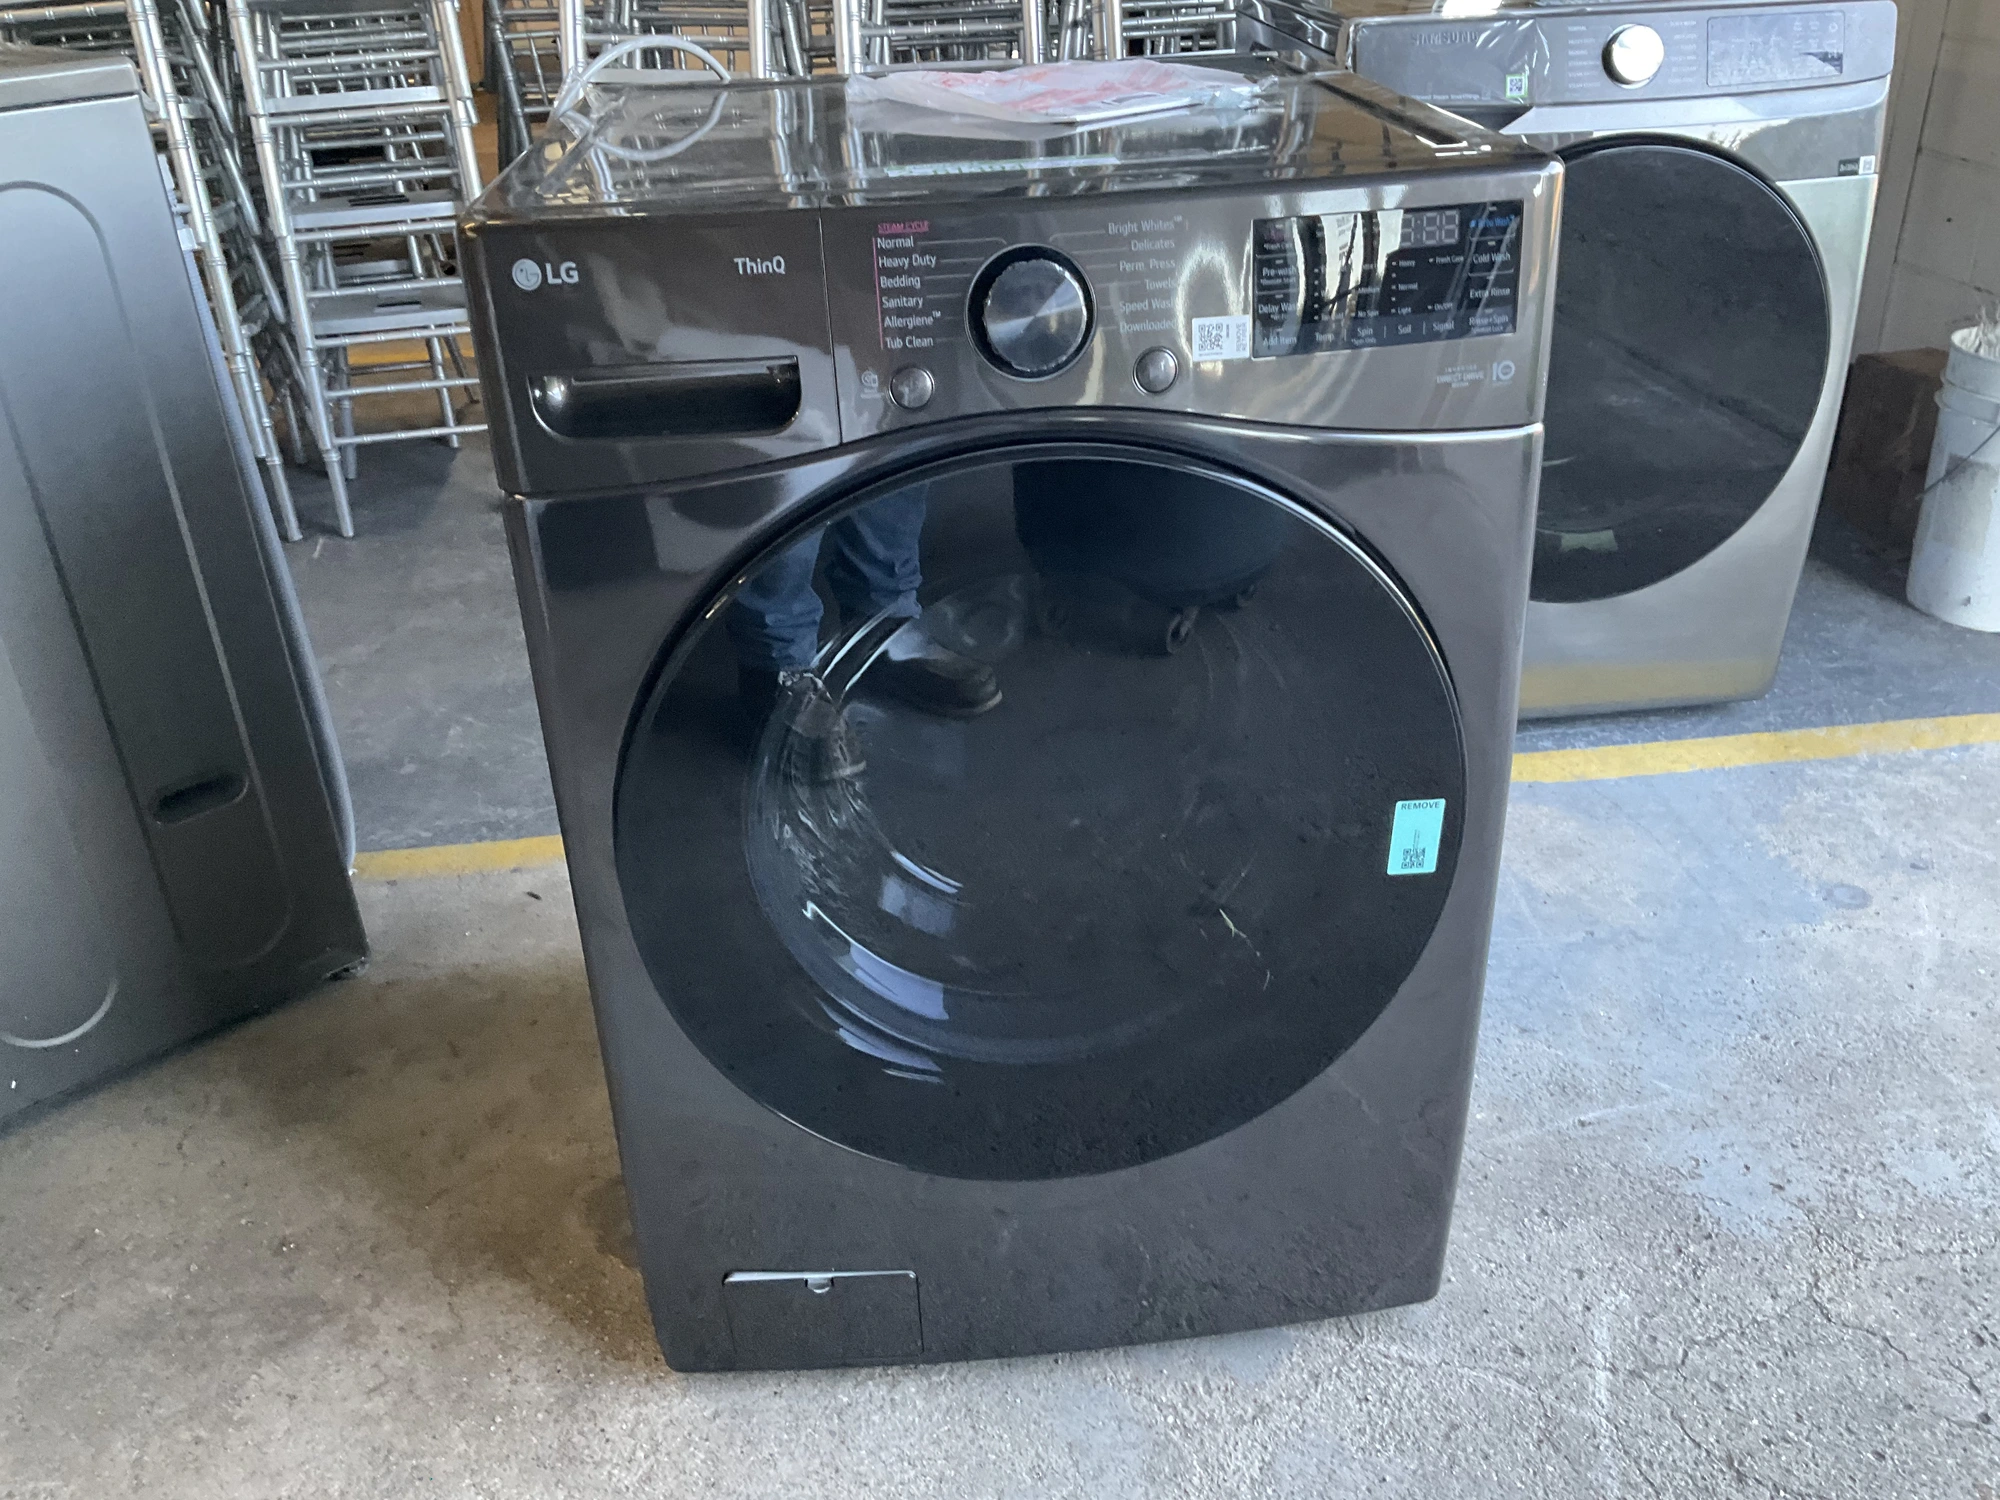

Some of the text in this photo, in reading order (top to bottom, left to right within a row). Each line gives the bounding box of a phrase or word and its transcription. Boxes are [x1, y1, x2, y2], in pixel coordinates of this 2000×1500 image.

[1108, 222, 1138, 236] Bright
[877, 236, 914, 249] Normal
[1131, 238, 1175, 251] Delicates
[878, 254, 936, 270] Heavy Duty
[1150, 258, 1175, 270] Press
[1472, 251, 1511, 264] Cold Wash
[734, 256, 785, 275] ThinQ
[546, 261, 579, 285] LG
[880, 275, 920, 289] Bedding
[1145, 278, 1175, 290] Towels
[1470, 287, 1510, 299] Extra Rinse
[882, 296, 923, 309] Sanitary
[1119, 300, 1148, 313] Speed
[1258, 304, 1279, 315] Delay
[1120, 318, 1176, 334] Downloaded
[1357, 327, 1373, 337] Spin
[1398, 324, 1412, 335] Soil
[1433, 321, 1455, 332] Signal
[885, 335, 934, 349] Tub Clean
[1315, 331, 1334, 342] Temp
[1401, 801, 1440, 811] REMOVE
